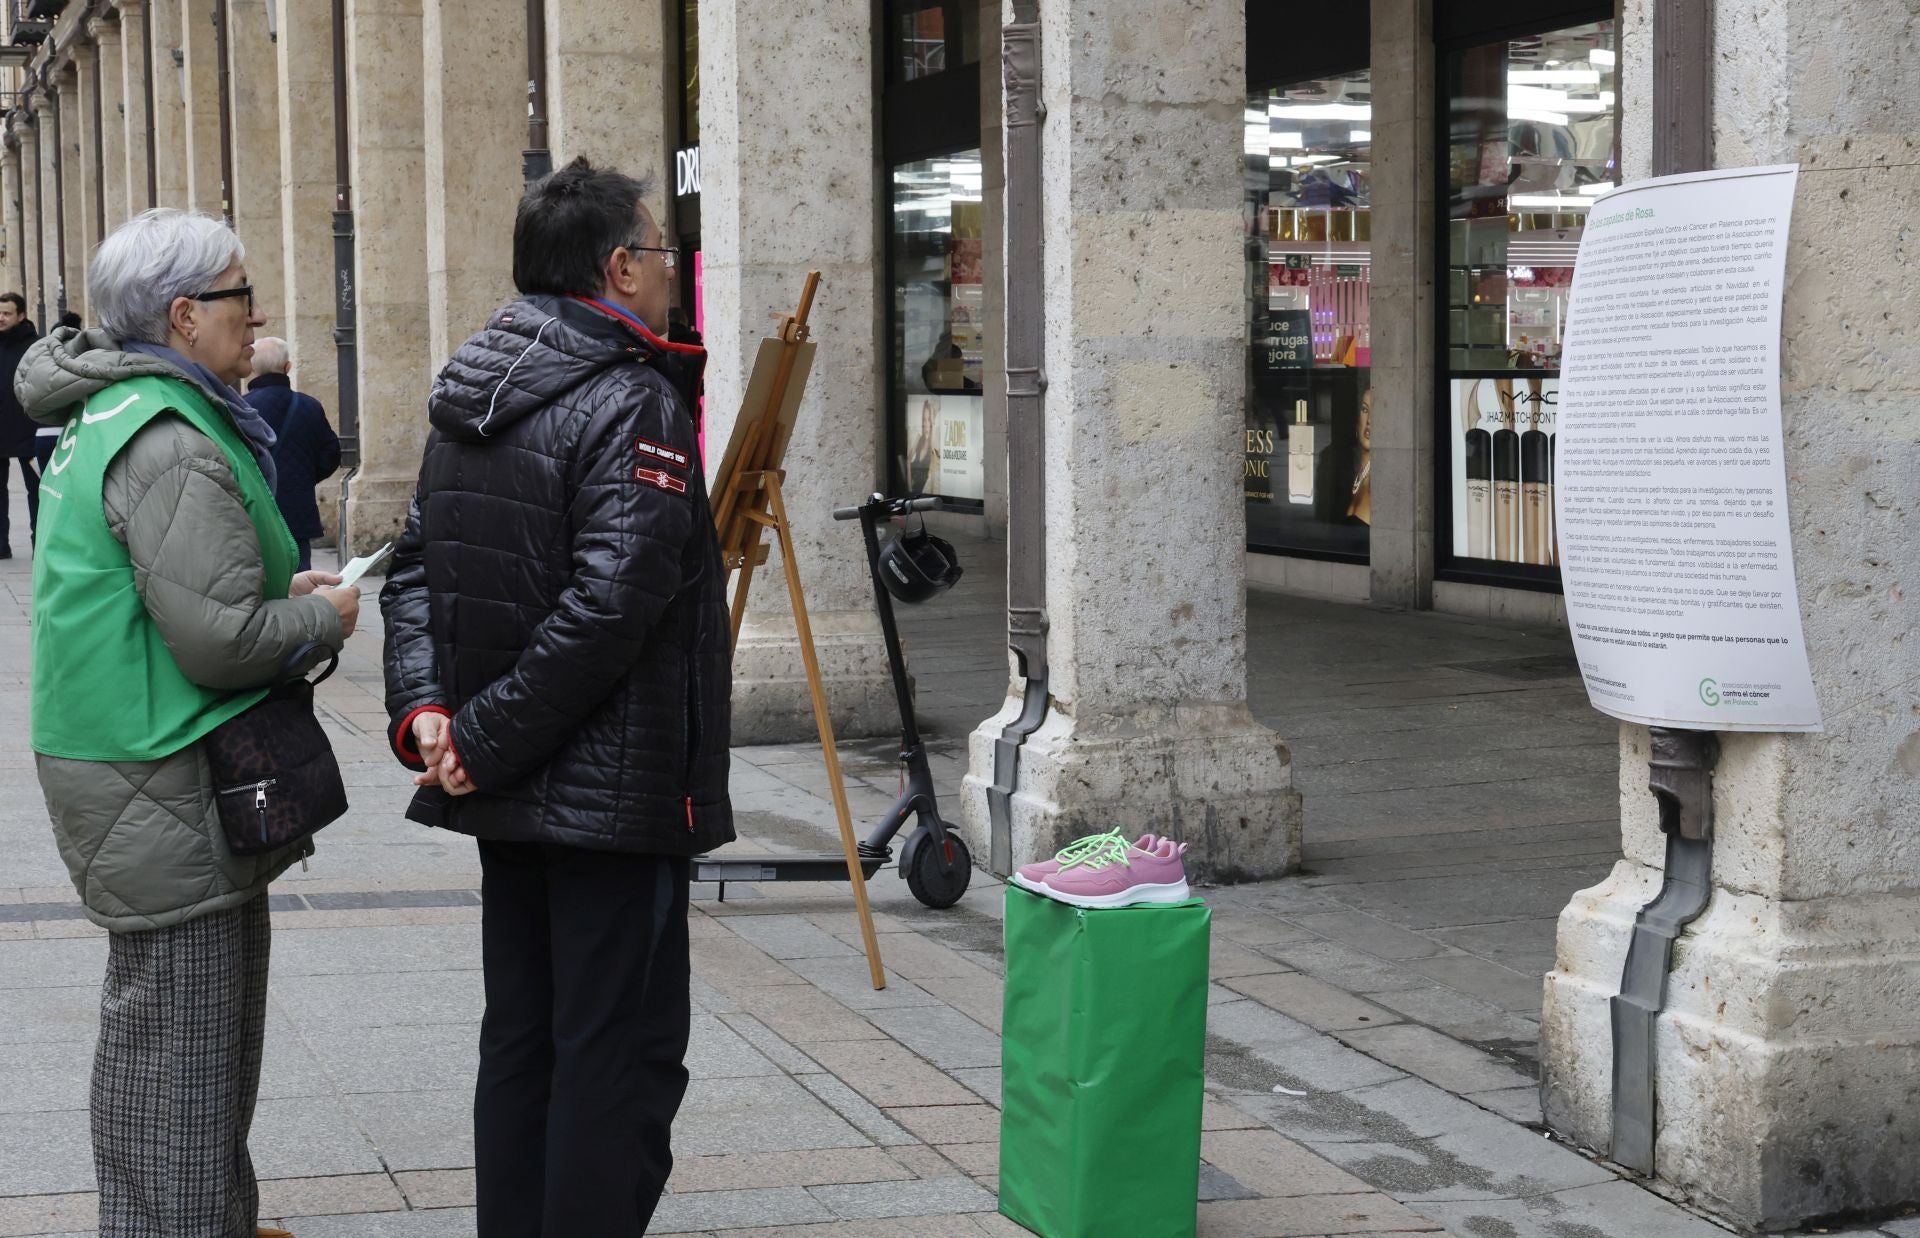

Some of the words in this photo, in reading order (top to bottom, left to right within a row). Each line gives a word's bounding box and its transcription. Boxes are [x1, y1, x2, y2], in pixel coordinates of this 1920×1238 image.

[1634, 207, 1655, 219] Rosa.
[1744, 218, 1766, 227] porque
[1726, 280, 1749, 289] Navidad
[1700, 345, 1714, 353] Todo
[1722, 345, 1732, 353] que
[1734, 343, 1758, 351] hacemos
[1729, 383, 1750, 392] significa
[1752, 382, 1766, 390] estar
[1744, 394, 1767, 402] estamos
[1706, 407, 1723, 415] donde
[1723, 407, 1738, 416] haga
[1752, 406, 1760, 414] Es
[1532, 412, 1551, 424] CON
[943, 419, 967, 448] ZADIG
[1728, 434, 1744, 442] valoro
[1246, 429, 1274, 454] ESS
[1752, 458, 1770, 466] aporto
[1735, 486, 1745, 495] hay
[1724, 498, 1746, 507] dejando
[1750, 499, 1762, 507] que
[1713, 510, 1726, 518] para
[1716, 538, 1752, 547] trabajadores
[1716, 549, 1736, 557] unidos
[1736, 551, 1747, 559] por
[1756, 550, 1778, 558] mismo
[1684, 571, 1708, 579] sociedad
[1716, 588, 1728, 596] Que
[1737, 589, 1752, 598] deje
[1752, 589, 1769, 597] llevar
[1771, 591, 1782, 599] por
[1680, 597, 1700, 606] bonitas
[1707, 599, 1743, 609] gratificantes
[1745, 602, 1758, 610] que
[1660, 630, 1675, 640] gesto
[1675, 632, 1686, 641] que
[1687, 632, 1710, 642] permite
[1712, 635, 1724, 643] que
[1724, 634, 1734, 642] las
[1735, 636, 1766, 644] personas
[1766, 637, 1779, 645] que
[1780, 636, 1788, 644] lo
[1732, 698, 1759, 706] Palencia
